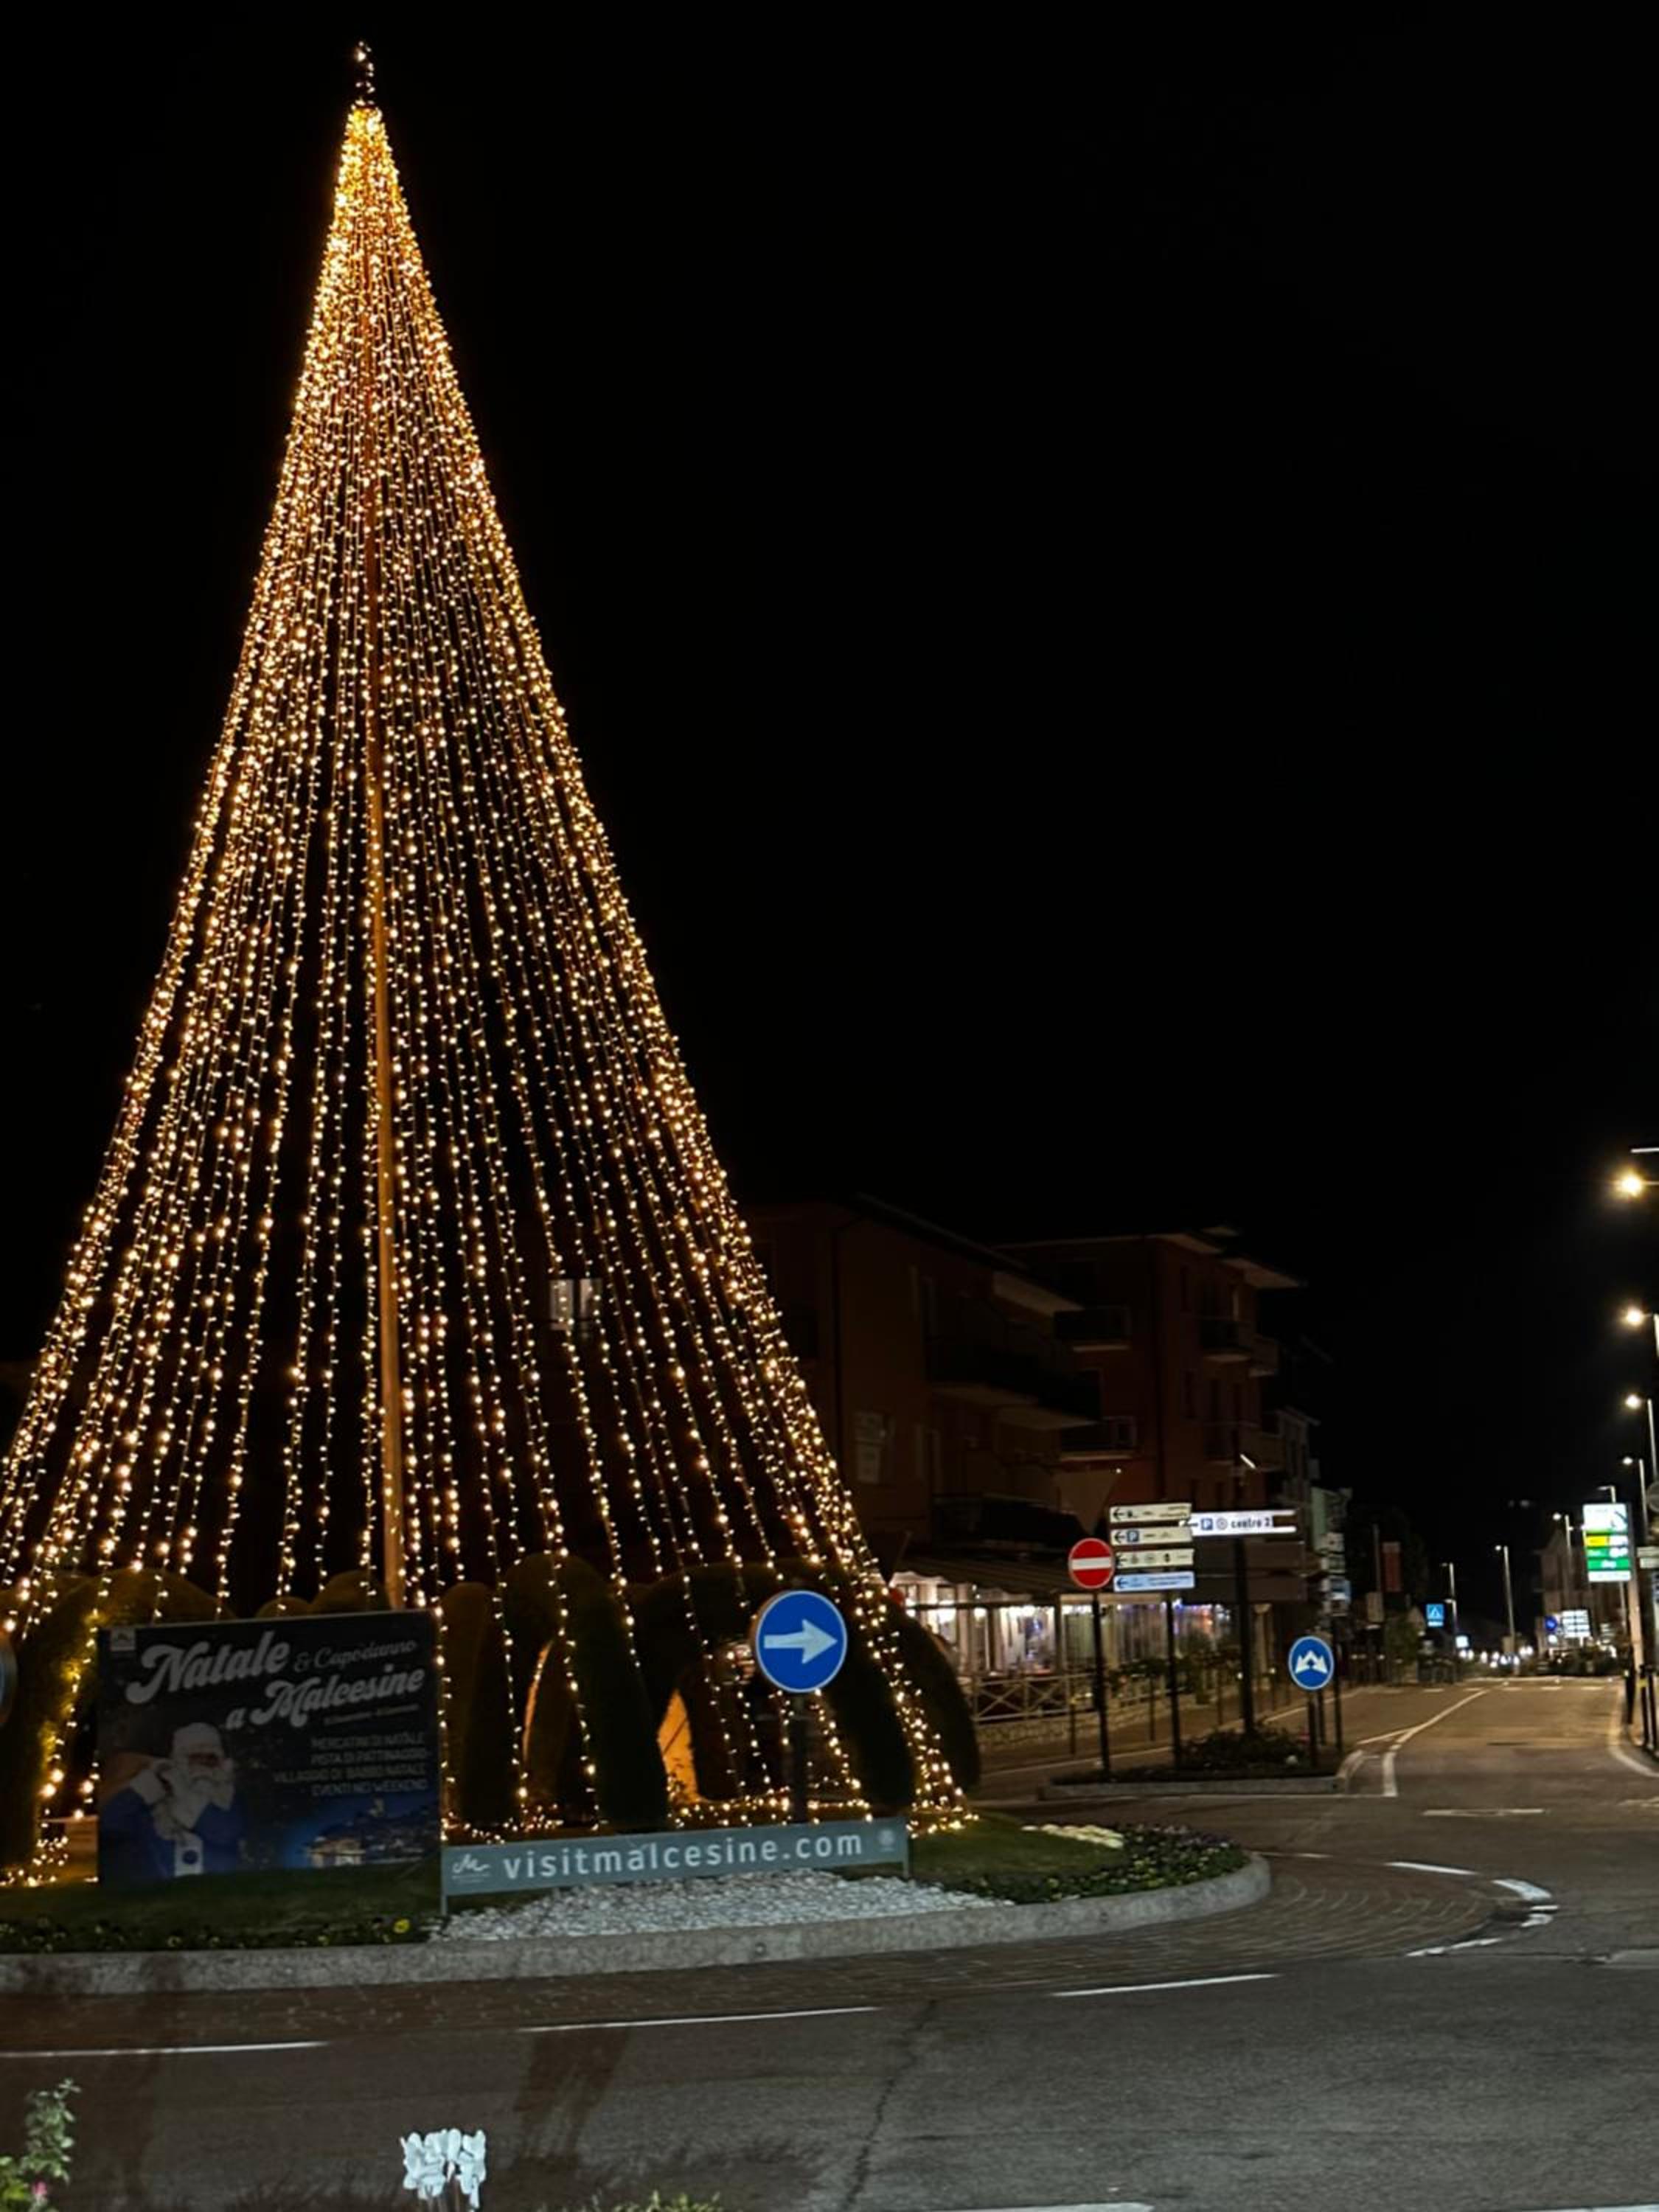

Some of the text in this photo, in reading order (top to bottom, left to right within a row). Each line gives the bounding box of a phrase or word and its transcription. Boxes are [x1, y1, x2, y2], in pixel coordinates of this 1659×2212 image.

[1231, 1516, 1262, 1528] centro
[125, 1630, 418, 1705] Natale & Capodanno
[226, 1707, 246, 1731] a
[249, 1664, 426, 1728] Malcesine
[385, 1731, 425, 1745] NATALE
[503, 1831, 862, 1879] visitmalcesine.com
